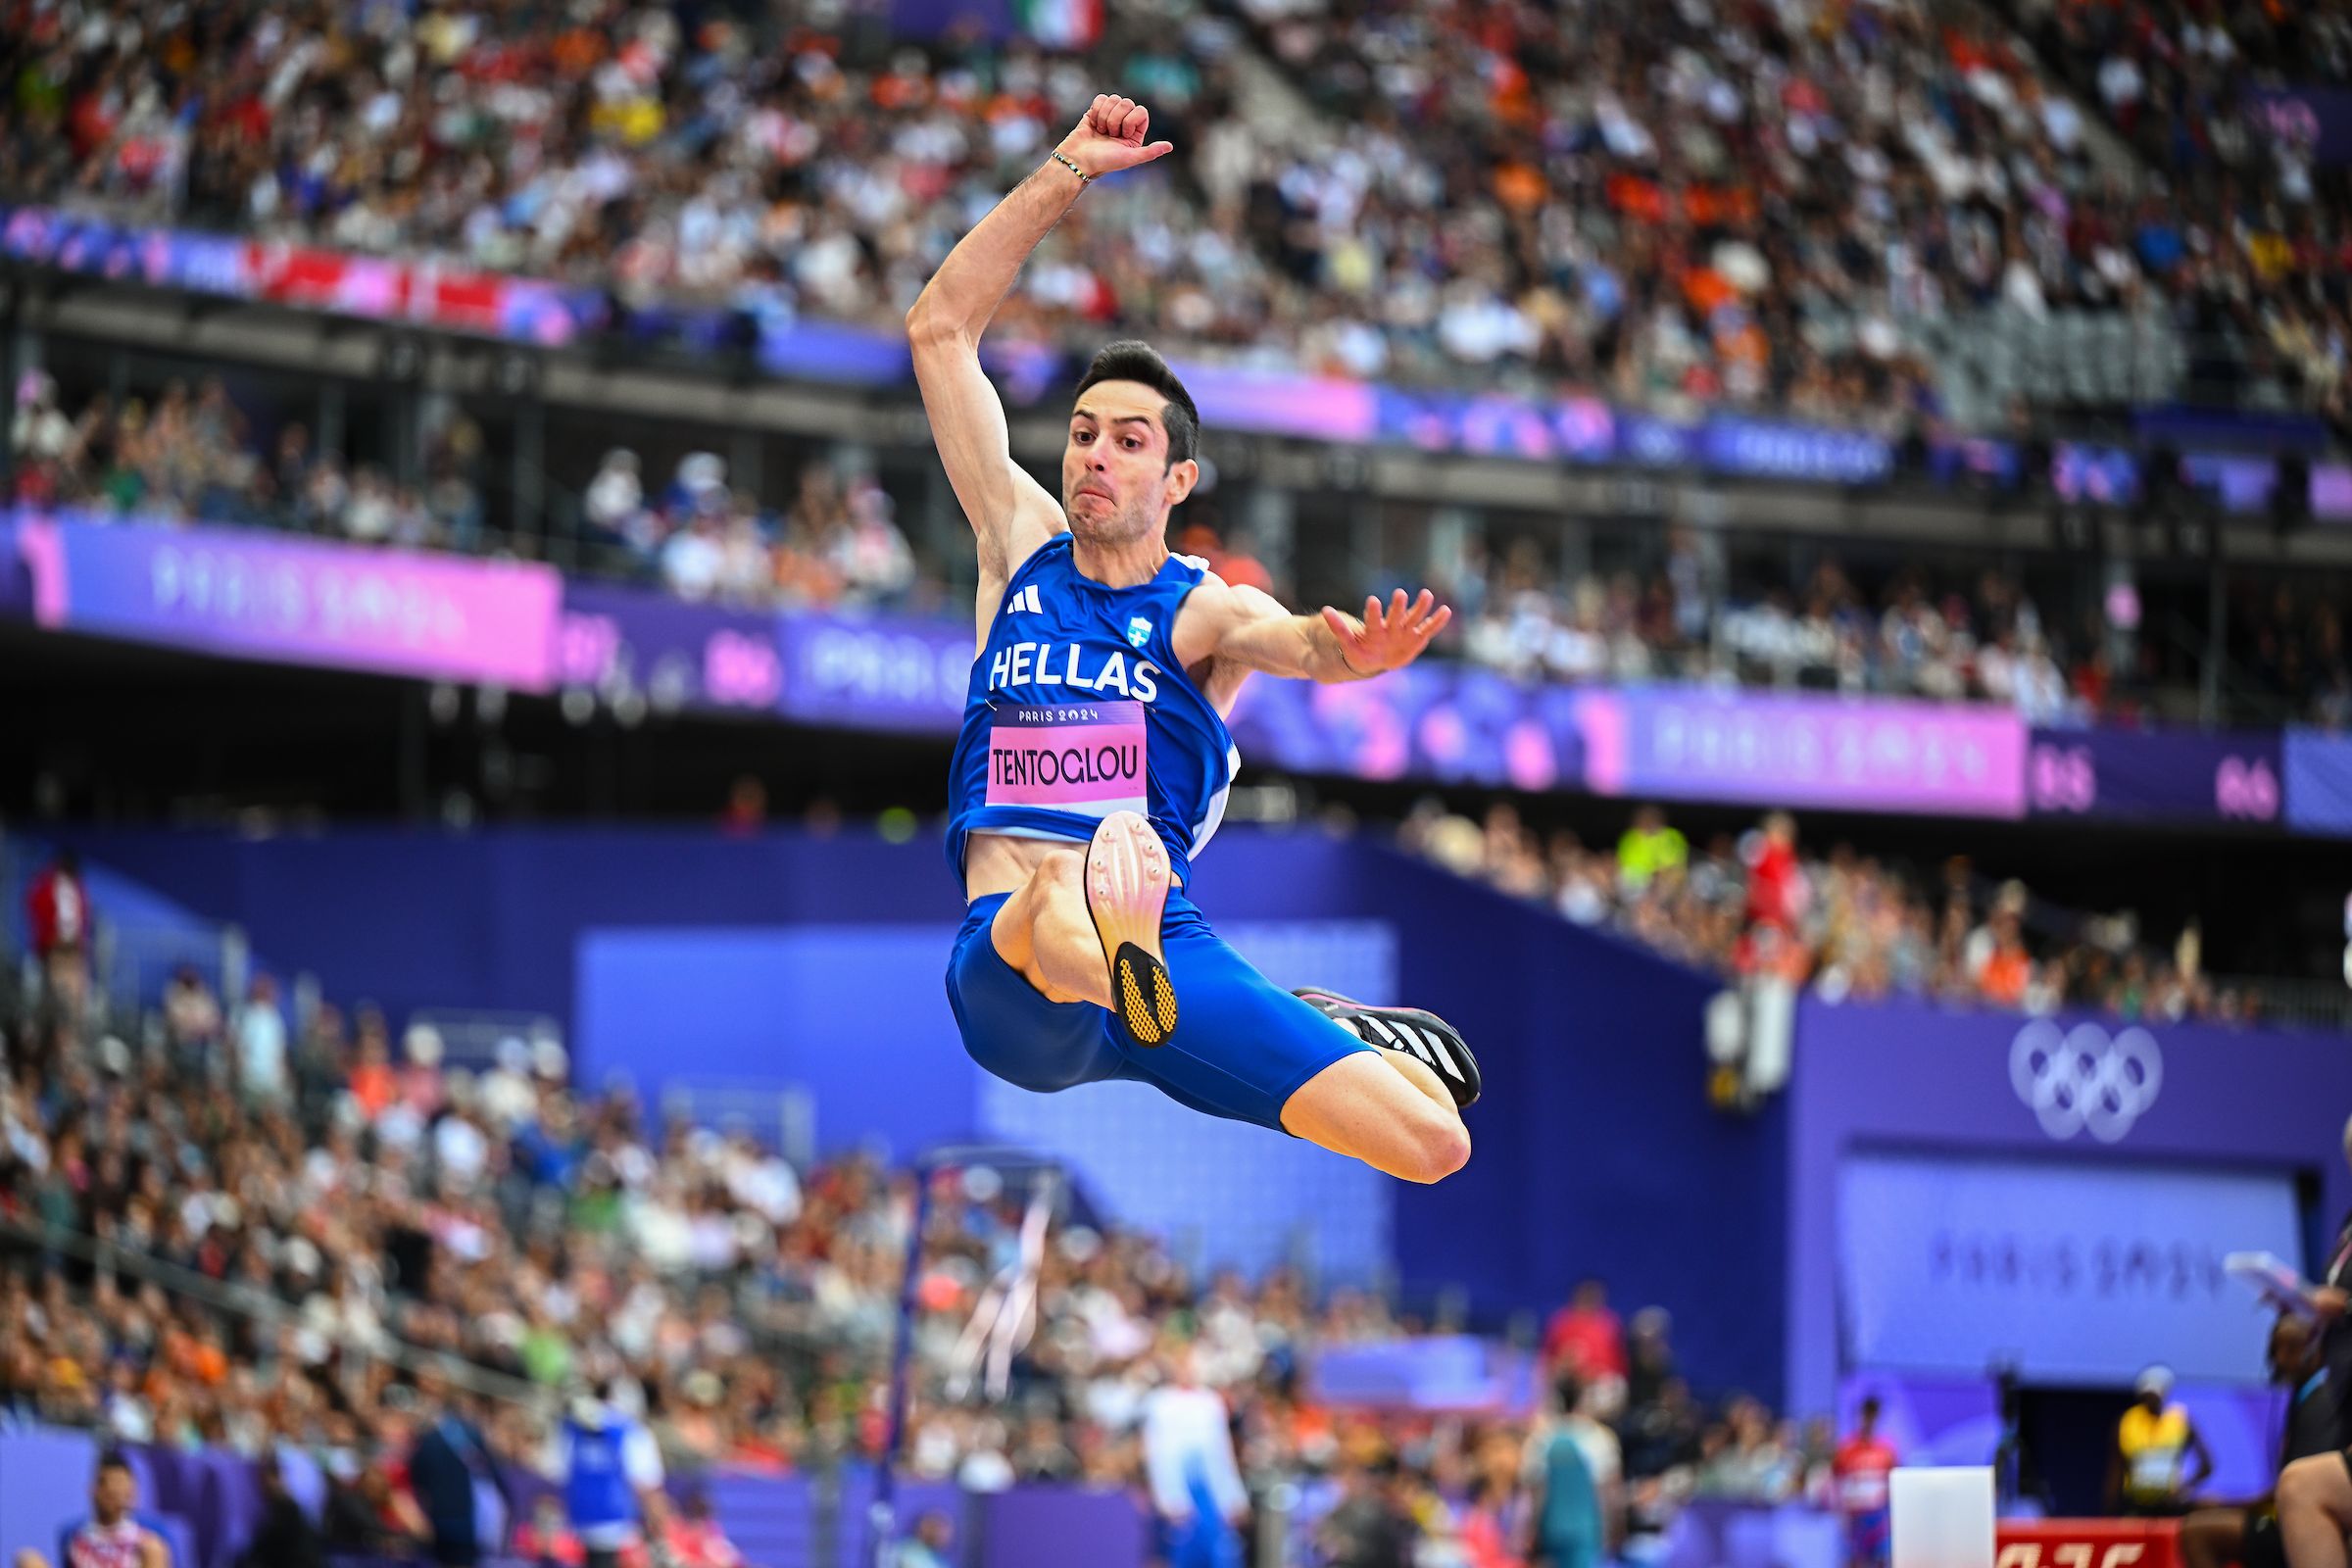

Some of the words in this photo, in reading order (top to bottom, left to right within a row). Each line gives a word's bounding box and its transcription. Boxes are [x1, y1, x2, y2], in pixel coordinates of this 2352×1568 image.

[989, 642, 1161, 703] HELLAS
[1019, 710, 1054, 722] PARIS
[1058, 708, 1098, 722] 2024
[993, 745, 1138, 786] TENTOGLOU
